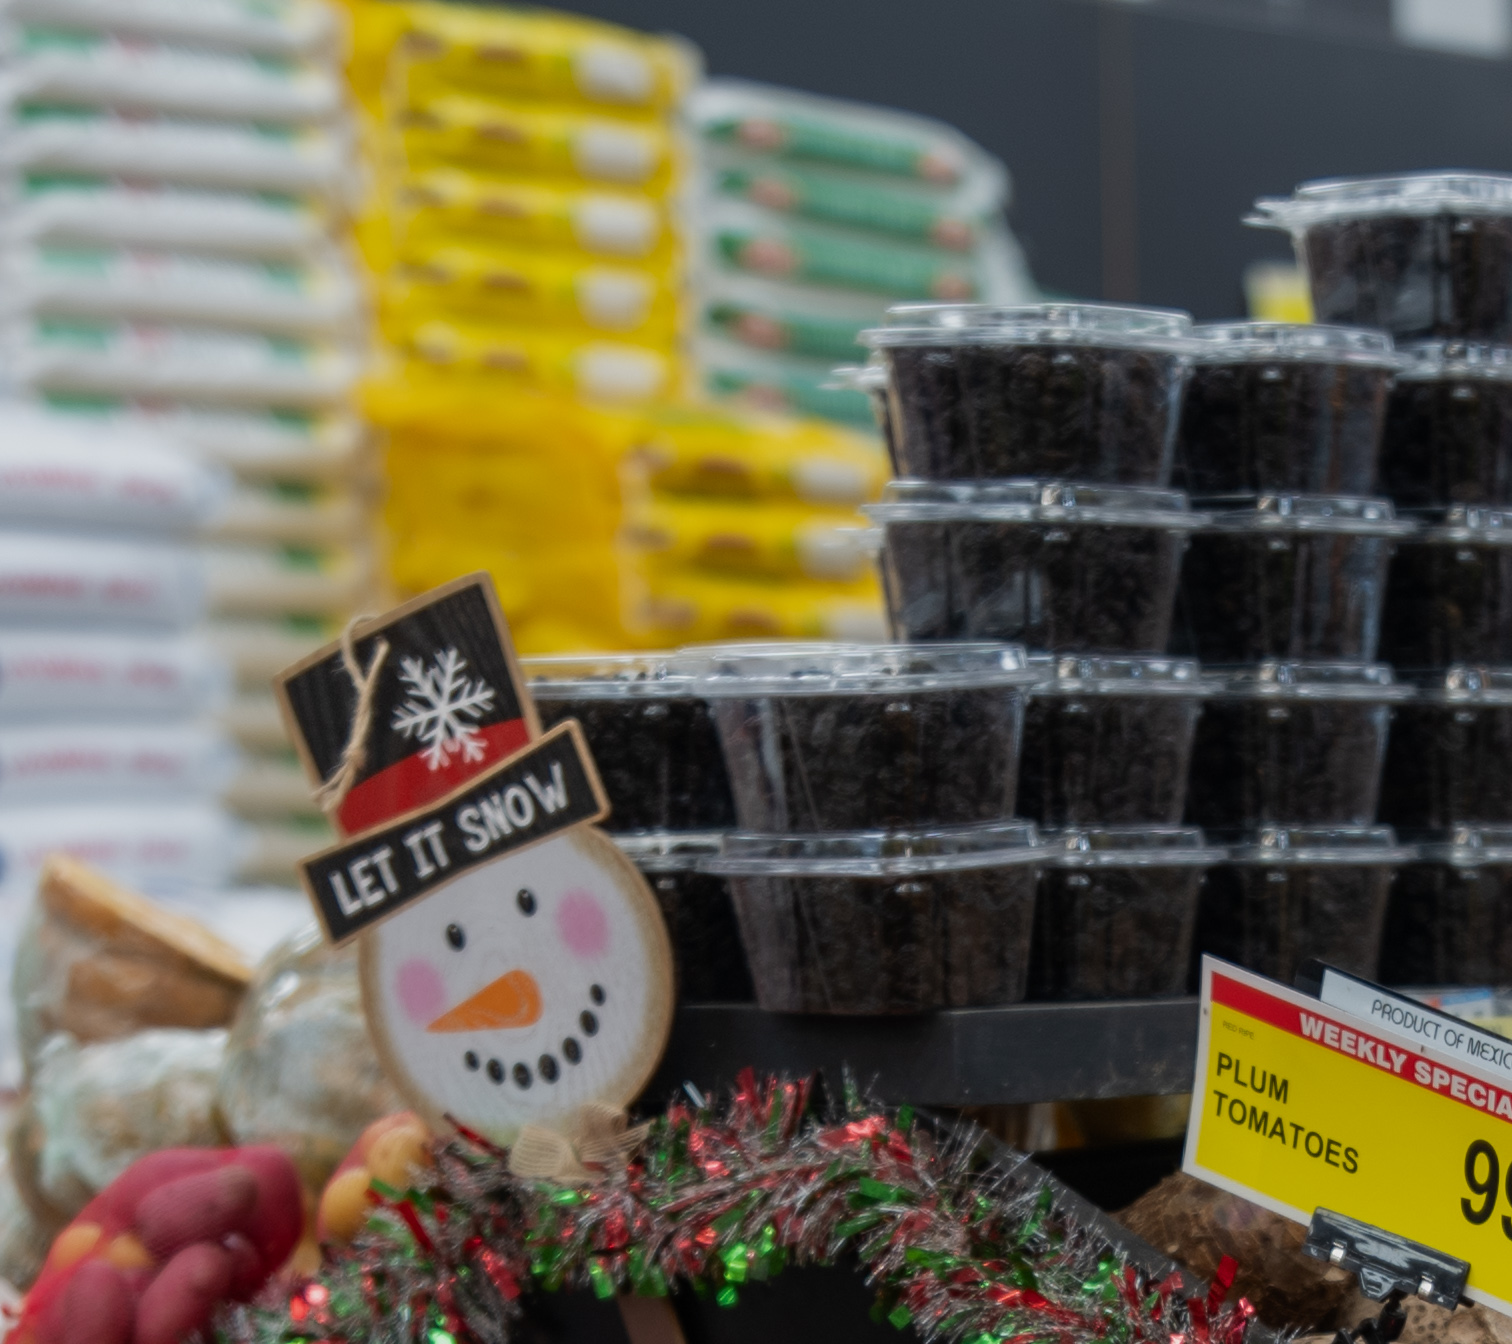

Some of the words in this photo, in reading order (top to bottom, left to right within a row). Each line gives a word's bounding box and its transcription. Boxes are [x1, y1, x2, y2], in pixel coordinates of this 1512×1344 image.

[328, 845, 399, 917] LET
[402, 819, 450, 880] IT
[455, 760, 568, 853] SNOW
[1299, 1012, 1407, 1074] WEEKLY
[1371, 999, 1441, 1040] PRODUCT
[1444, 1029, 1464, 1049] OF
[1216, 1052, 1290, 1104] PLUM
[1213, 1089, 1360, 1174] TOMATOES
